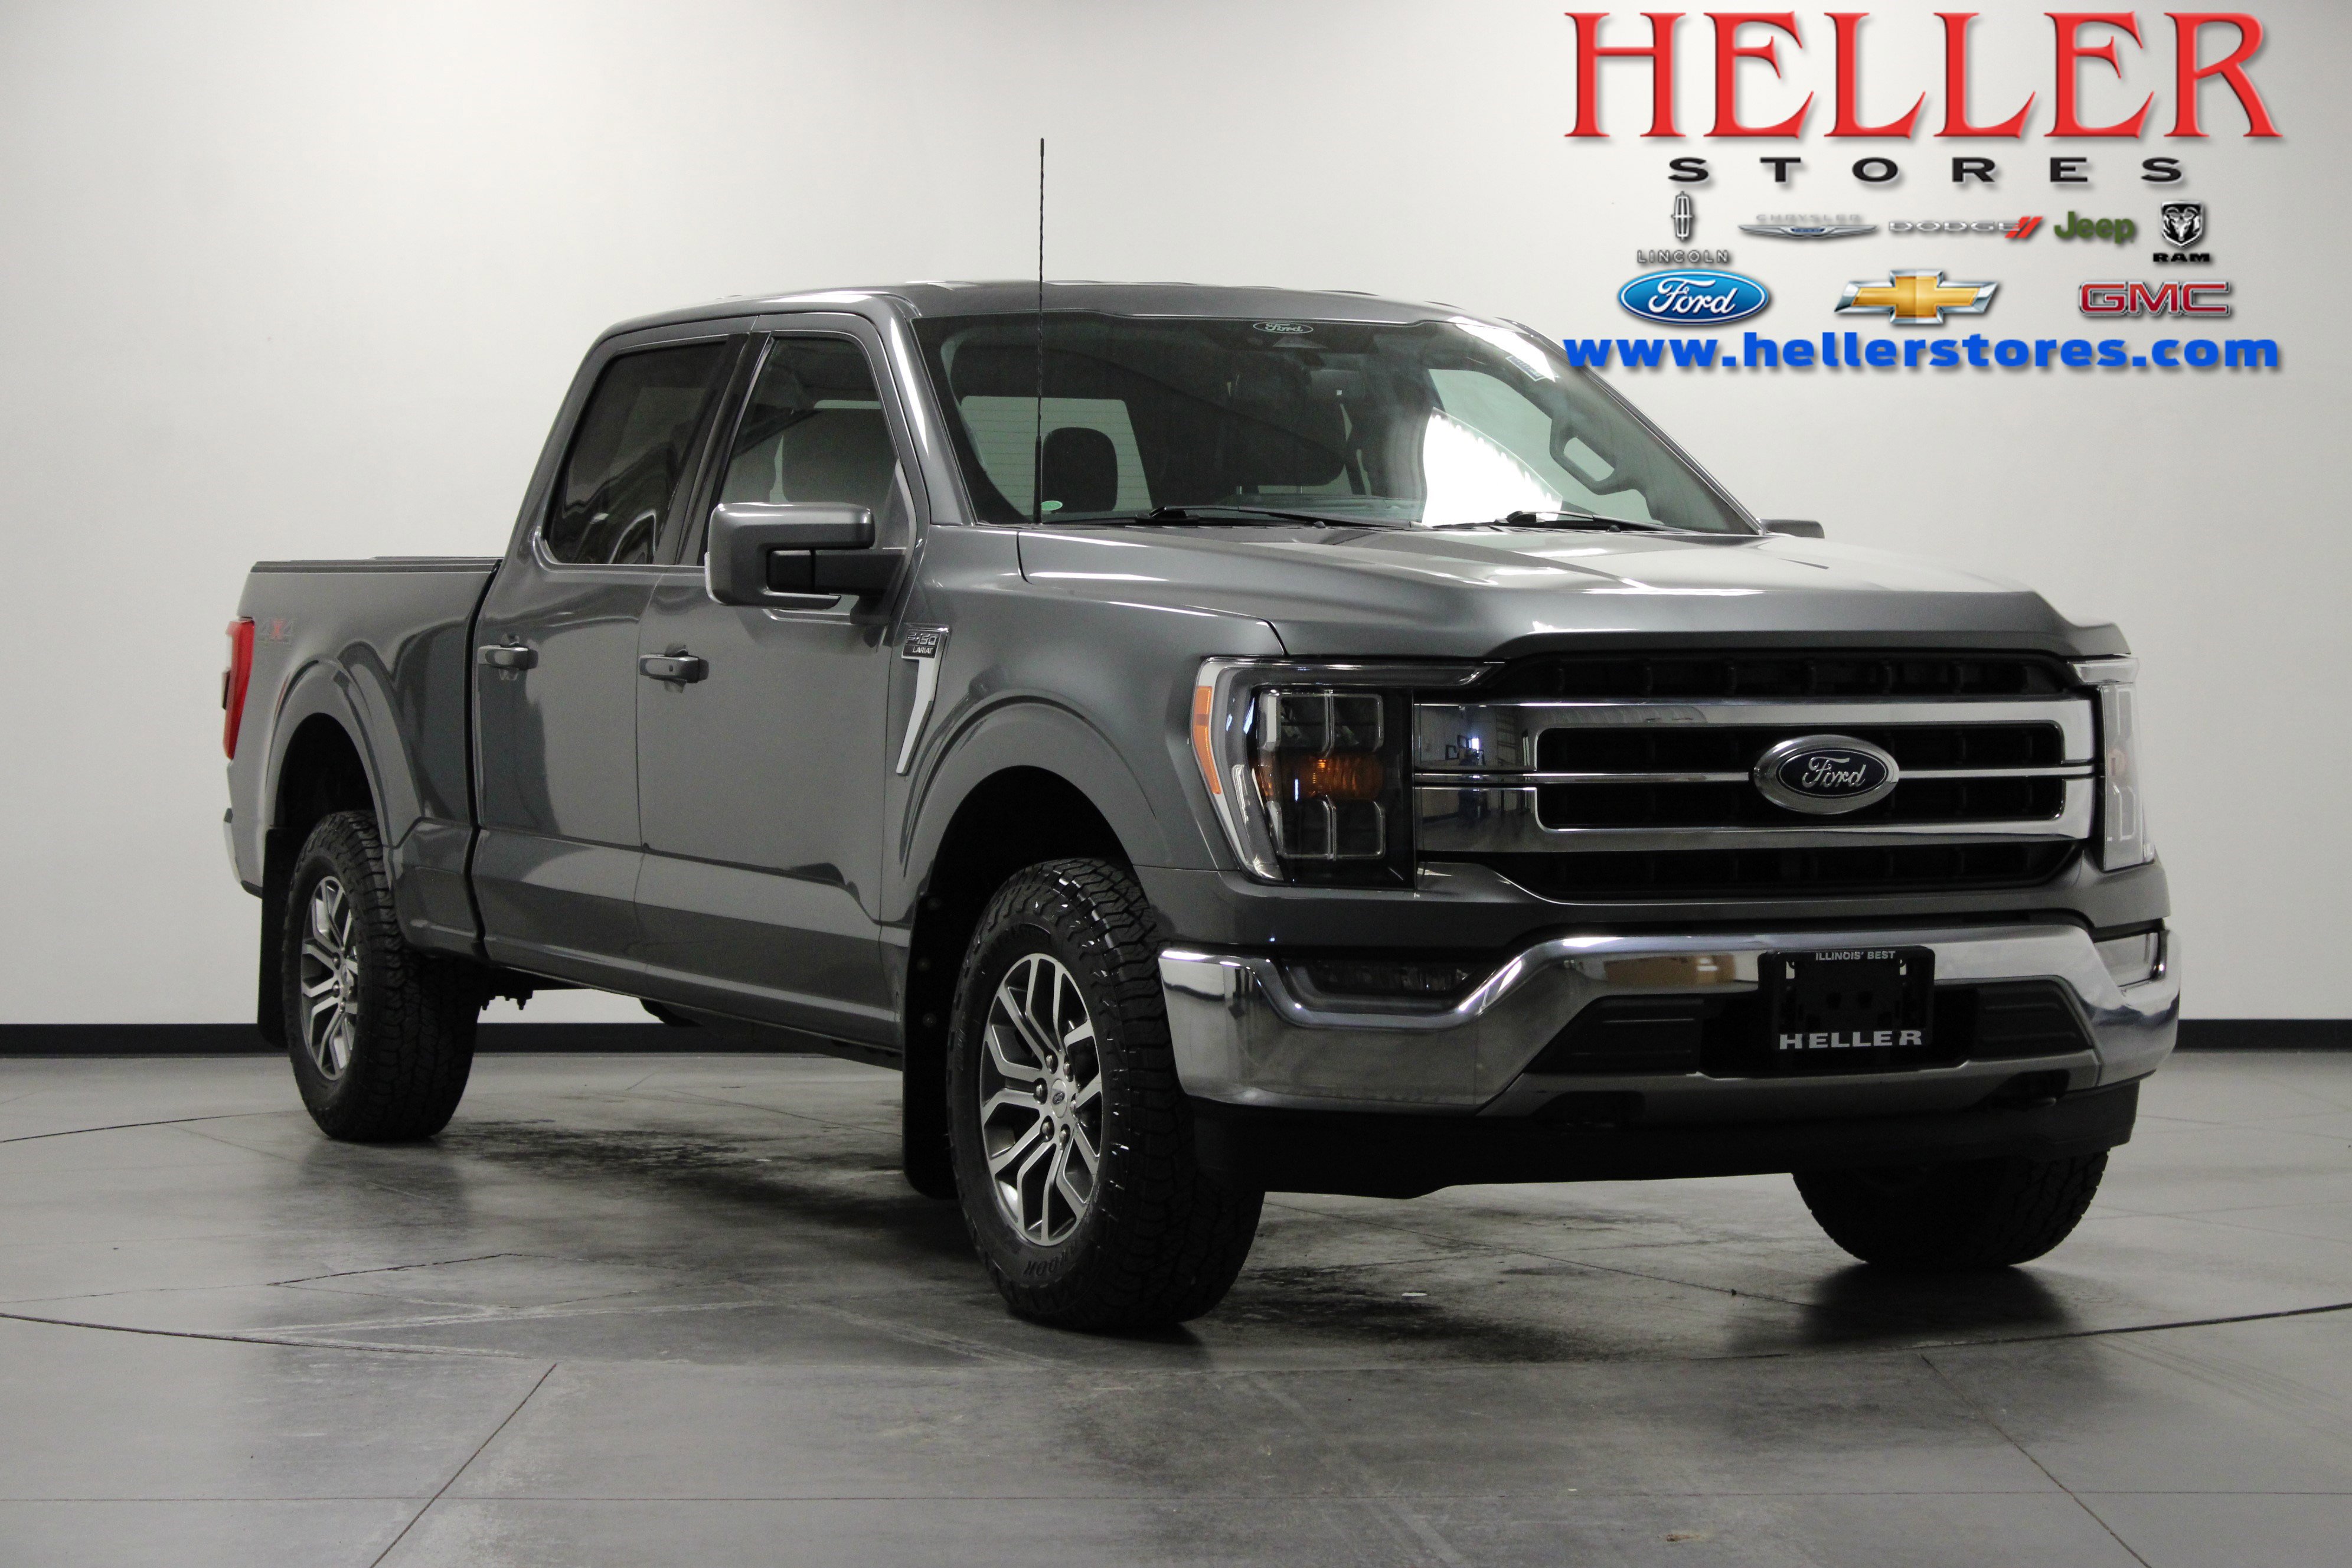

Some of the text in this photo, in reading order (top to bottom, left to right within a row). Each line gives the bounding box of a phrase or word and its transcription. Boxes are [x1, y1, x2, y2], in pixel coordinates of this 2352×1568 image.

[1265, 323, 1303, 332] Ford
[1802, 756, 1867, 788] Ford
[1815, 950, 1896, 961] ILLINOIS' BEST
[1779, 1030, 1922, 1050] HELLER
